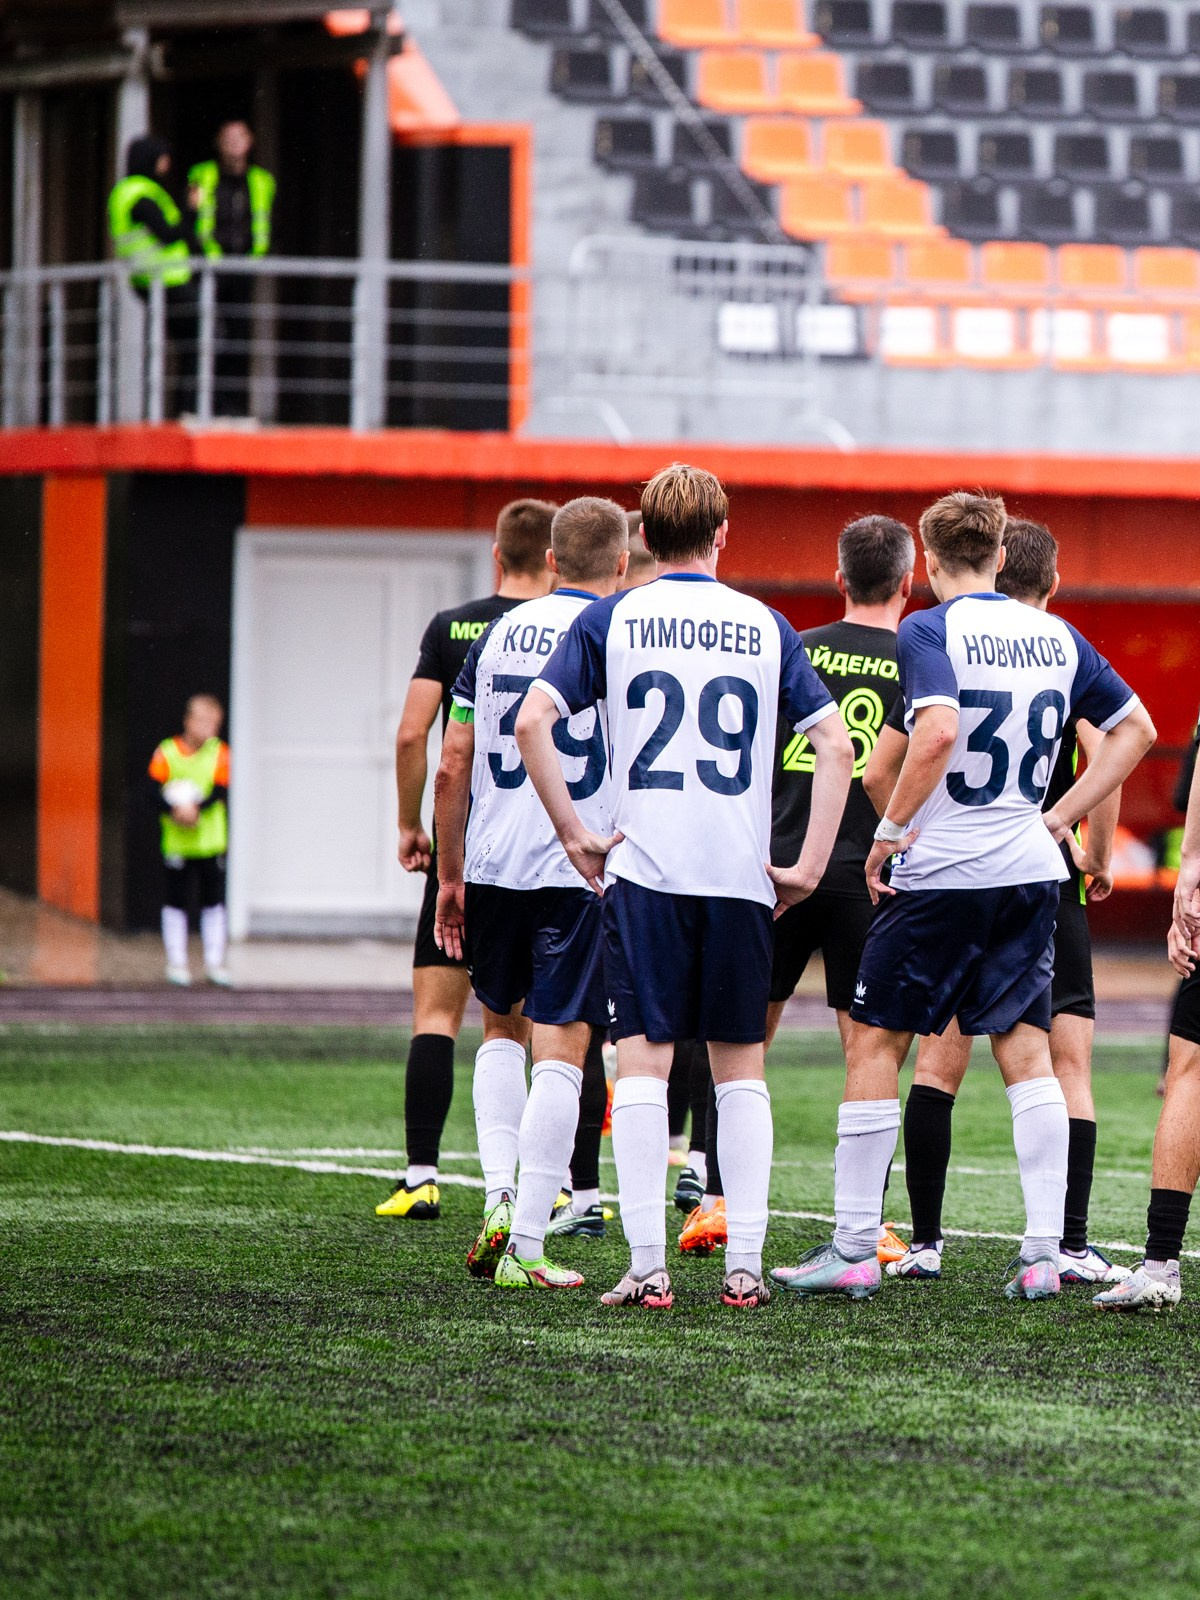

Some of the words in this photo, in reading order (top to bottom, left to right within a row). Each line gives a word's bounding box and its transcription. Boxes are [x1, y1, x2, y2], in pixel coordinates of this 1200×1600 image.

[451, 621, 490, 640] МО
[503, 624, 569, 656] КОБ
[624, 617, 762, 656] ТИМОФЕЕВ
[804, 645, 900, 682] ЙДЕНО
[962, 634, 1067, 669] НОВИКОВ
[487, 674, 607, 801] 39
[626, 669, 759, 797] 29
[945, 689, 1066, 807] 38
